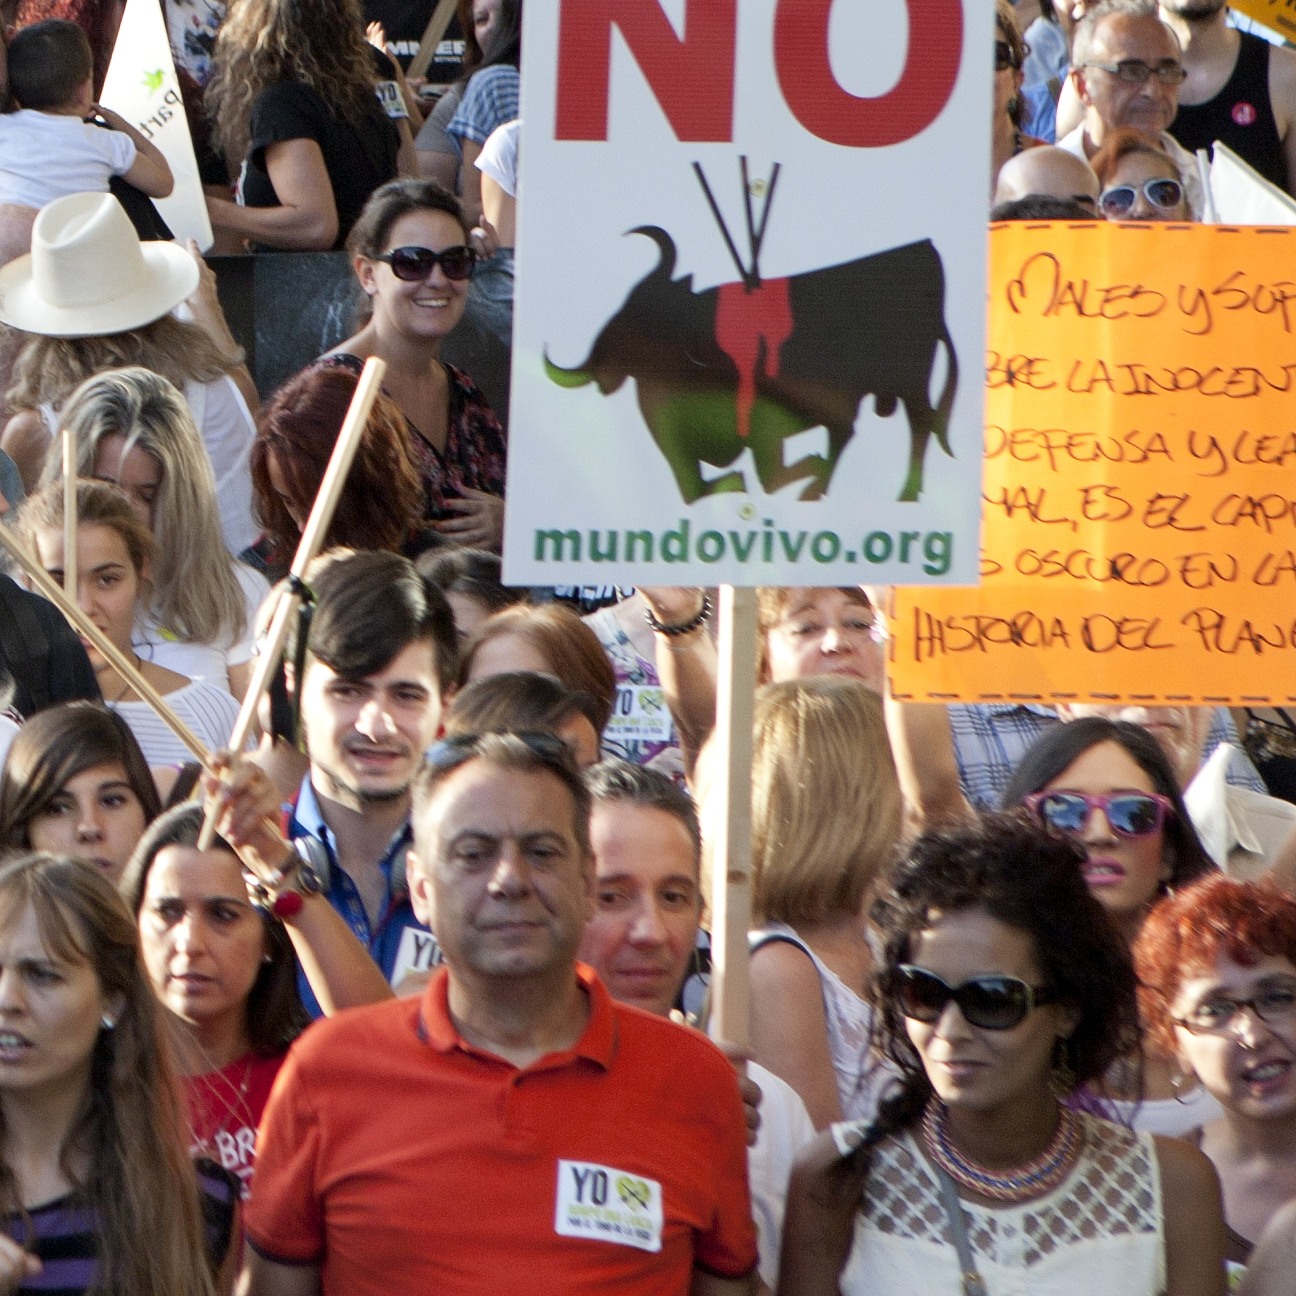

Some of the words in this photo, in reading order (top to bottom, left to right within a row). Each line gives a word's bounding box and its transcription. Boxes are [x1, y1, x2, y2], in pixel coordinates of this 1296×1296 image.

[1006, 251, 1168, 320] MALES
[984, 424, 1176, 472] DEFENSA
[1081, 485, 1133, 522] ES
[1142, 492, 1206, 532] EL
[532, 519, 954, 577] mundovivo.org
[1014, 548, 1172, 587] OSCURO
[1174, 552, 1239, 590] EN
[1252, 549, 1296, 587] LA
[913, 605, 1071, 663] HISTORIA
[1080, 613, 1176, 653] DEL
[570, 1165, 609, 1206] YO
